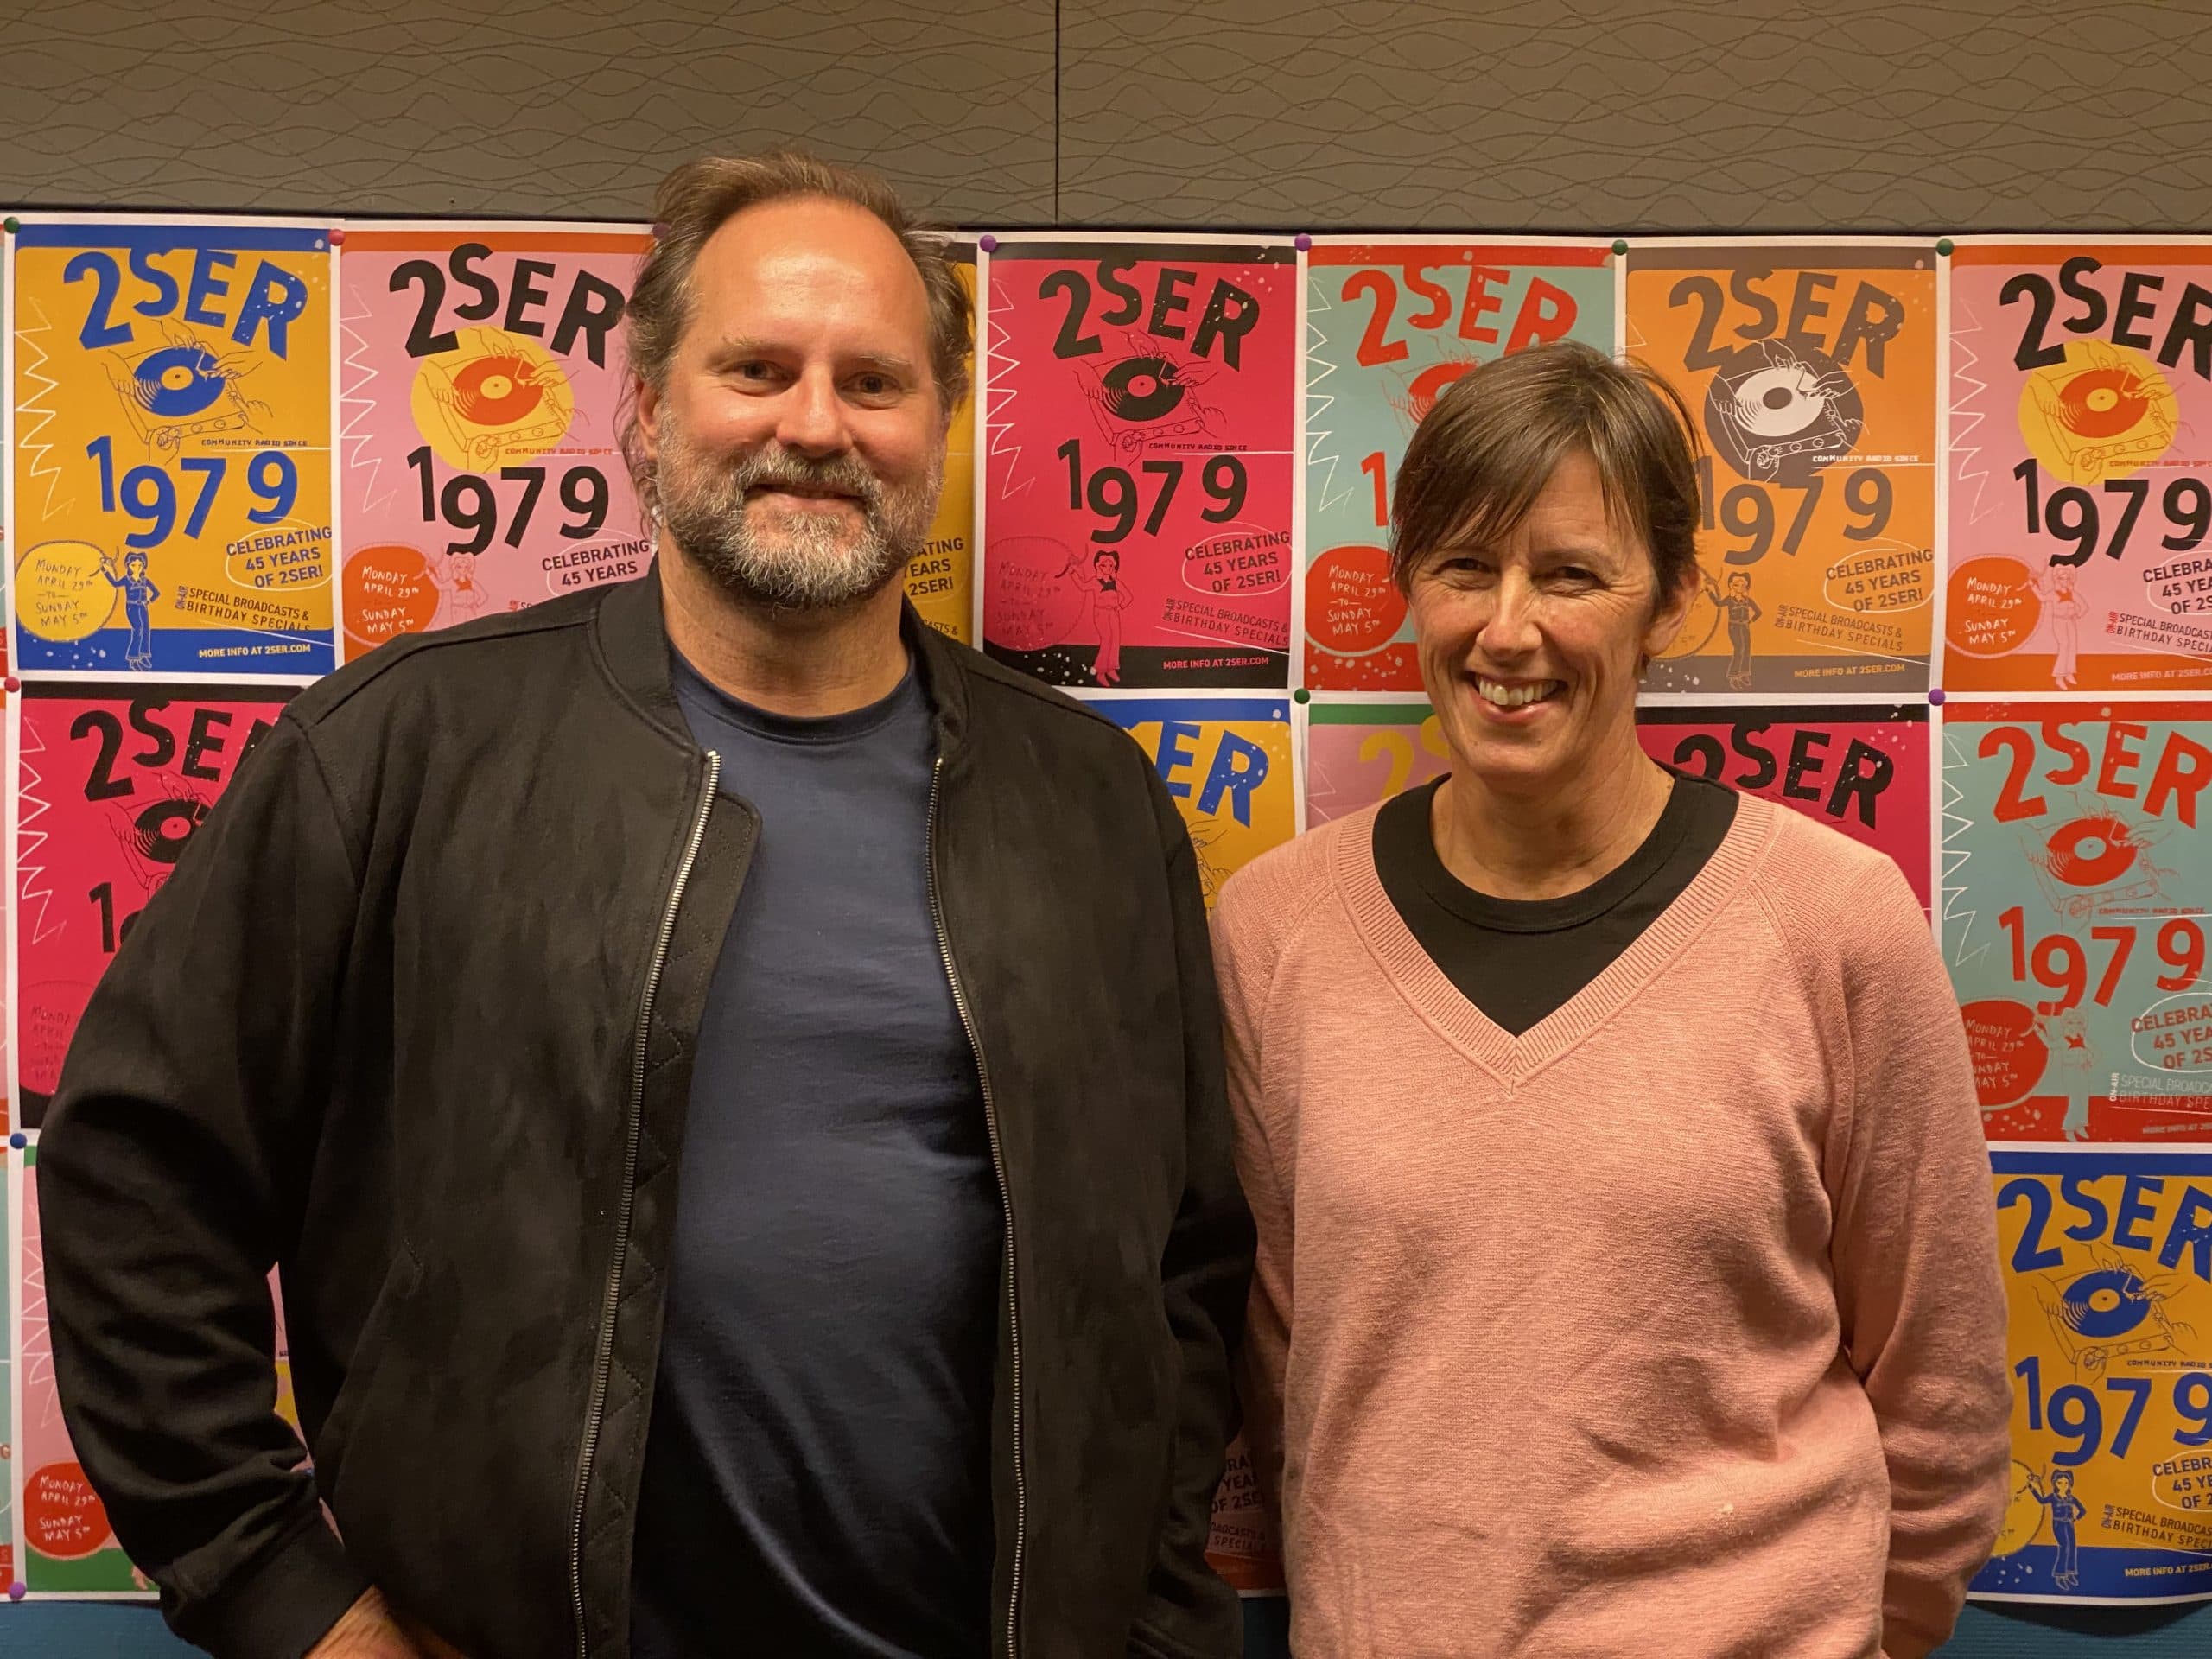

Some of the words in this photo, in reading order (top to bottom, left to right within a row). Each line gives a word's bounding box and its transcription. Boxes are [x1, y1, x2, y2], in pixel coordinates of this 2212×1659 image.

[63, 248, 308, 361] 2SER
[389, 242, 626, 370] 2SER
[1039, 260, 1261, 372] 2SER
[1341, 264, 1578, 367] 2SER
[1669, 270, 1905, 380] 2SER
[1999, 256, 2212, 382] 2SER
[86, 435, 298, 549] 1979
[406, 446, 609, 556] 1979
[1057, 439, 1248, 543] 1979
[1695, 455, 1893, 566] 1979
[2012, 458, 2212, 568] 1979
[226, 526, 332, 556] CELEBRATING
[1185, 531, 1290, 561] CELEBRATING
[245, 556, 264, 571] 45
[269, 547, 321, 567] YEARS
[542, 539, 650, 571] CELEBRATING
[1204, 562, 1223, 575] 45
[1227, 551, 1279, 572] YEARS
[1826, 549, 1934, 581] CELEBRATING
[35, 559, 81, 577] MONDAY
[255, 574, 274, 588] OF
[279, 565, 323, 584] 2SER!
[361, 565, 408, 585] MONDAY
[562, 571, 581, 586] 45
[586, 561, 638, 582] YEARS
[905, 558, 952, 578] EARS
[1329, 565, 1375, 584] MONDAY
[38, 575, 66, 588] APRIL
[364, 582, 393, 598] APRIL
[1212, 579, 1231, 593] OF
[1236, 569, 1281, 589] 2SER!
[1331, 582, 1360, 597] APRIL
[1845, 581, 1865, 594] 45
[1868, 569, 1921, 591] YEARS
[1967, 577, 2012, 595] MONDAY
[2162, 582, 2182, 596] 45
[36, 601, 79, 614] SUNDAY
[187, 601, 247, 622] BIRTHDAY
[189, 588, 231, 605] SPECIAL
[233, 596, 300, 620] BROADCASTS
[302, 610, 309, 621] &
[1853, 598, 1873, 612] OF
[1878, 588, 1923, 608] 2SER!
[1967, 593, 1997, 608] APRIL
[2171, 600, 2190, 615] OF
[2196, 595, 2212, 610] 2S
[41, 614, 67, 627] MAY
[361, 607, 406, 622] SUNDAY
[1177, 600, 1215, 617] SPECIAL
[1217, 608, 1279, 631] BROADCASTS
[1281, 622, 1288, 632] &
[1326, 608, 1371, 623] SUNDAY
[1789, 607, 1828, 624] SPECIAL
[1830, 615, 1893, 638] BROADCASTS
[1895, 627, 1903, 638] &
[1965, 619, 2009, 632] SUNDAY
[2119, 613, 2157, 629] SPECIAL
[367, 620, 393, 634] MAY
[1173, 612, 1230, 634] BIRTHDAY
[1235, 626, 1289, 646] SPECIALS
[1332, 622, 1360, 636] MAY
[1785, 619, 1844, 639] BIRTHDAY
[1847, 631, 1904, 652] SPECIALS
[1970, 633, 1995, 645] MAY
[2117, 626, 2173, 645] BIRTHDAY
[199, 649, 225, 658] MORE
[228, 648, 249, 657] INFO
[251, 646, 263, 655] AT
[264, 644, 311, 655] 2SER.COM
[1163, 661, 1188, 670] MORE
[1190, 659, 1210, 668] INFO
[1211, 658, 1224, 667] AT
[1225, 657, 1269, 666] 2SER.COM
[1794, 669, 1821, 677] MORE
[1823, 668, 1842, 677] INFO
[1859, 664, 1905, 674] 2SER.COM
[1154, 722, 1269, 829] ER
[1978, 723, 2212, 830] 2SER
[1999, 906, 2206, 1016] 1979
[2131, 1004, 2212, 1033] CELEBRA
[2153, 1033, 2176, 1050] 45
[2179, 1025, 2212, 1046] YEA
[2164, 1052, 2186, 1069] OF
[2191, 1047, 2212, 1065] 2S
[2120, 1075, 2164, 1090] SPECIAL
[1997, 1175, 2212, 1285] 2SER
[2015, 1356, 2212, 1467] 1979
[2153, 1457, 2212, 1476] CELEBR
[40, 1475, 84, 1493] MONDAY
[2172, 1478, 2192, 1491] 45
[2182, 1494, 2202, 1509] OF
[39, 1515, 83, 1530] SUNDAY
[2116, 1507, 2158, 1526] SPECIAL
[2160, 1517, 2212, 1536] BROADCAS
[2113, 1521, 2174, 1541] BIRTHDAY
[2177, 1535, 2212, 1548] SPECI
[2125, 1568, 2152, 1577] MORE
